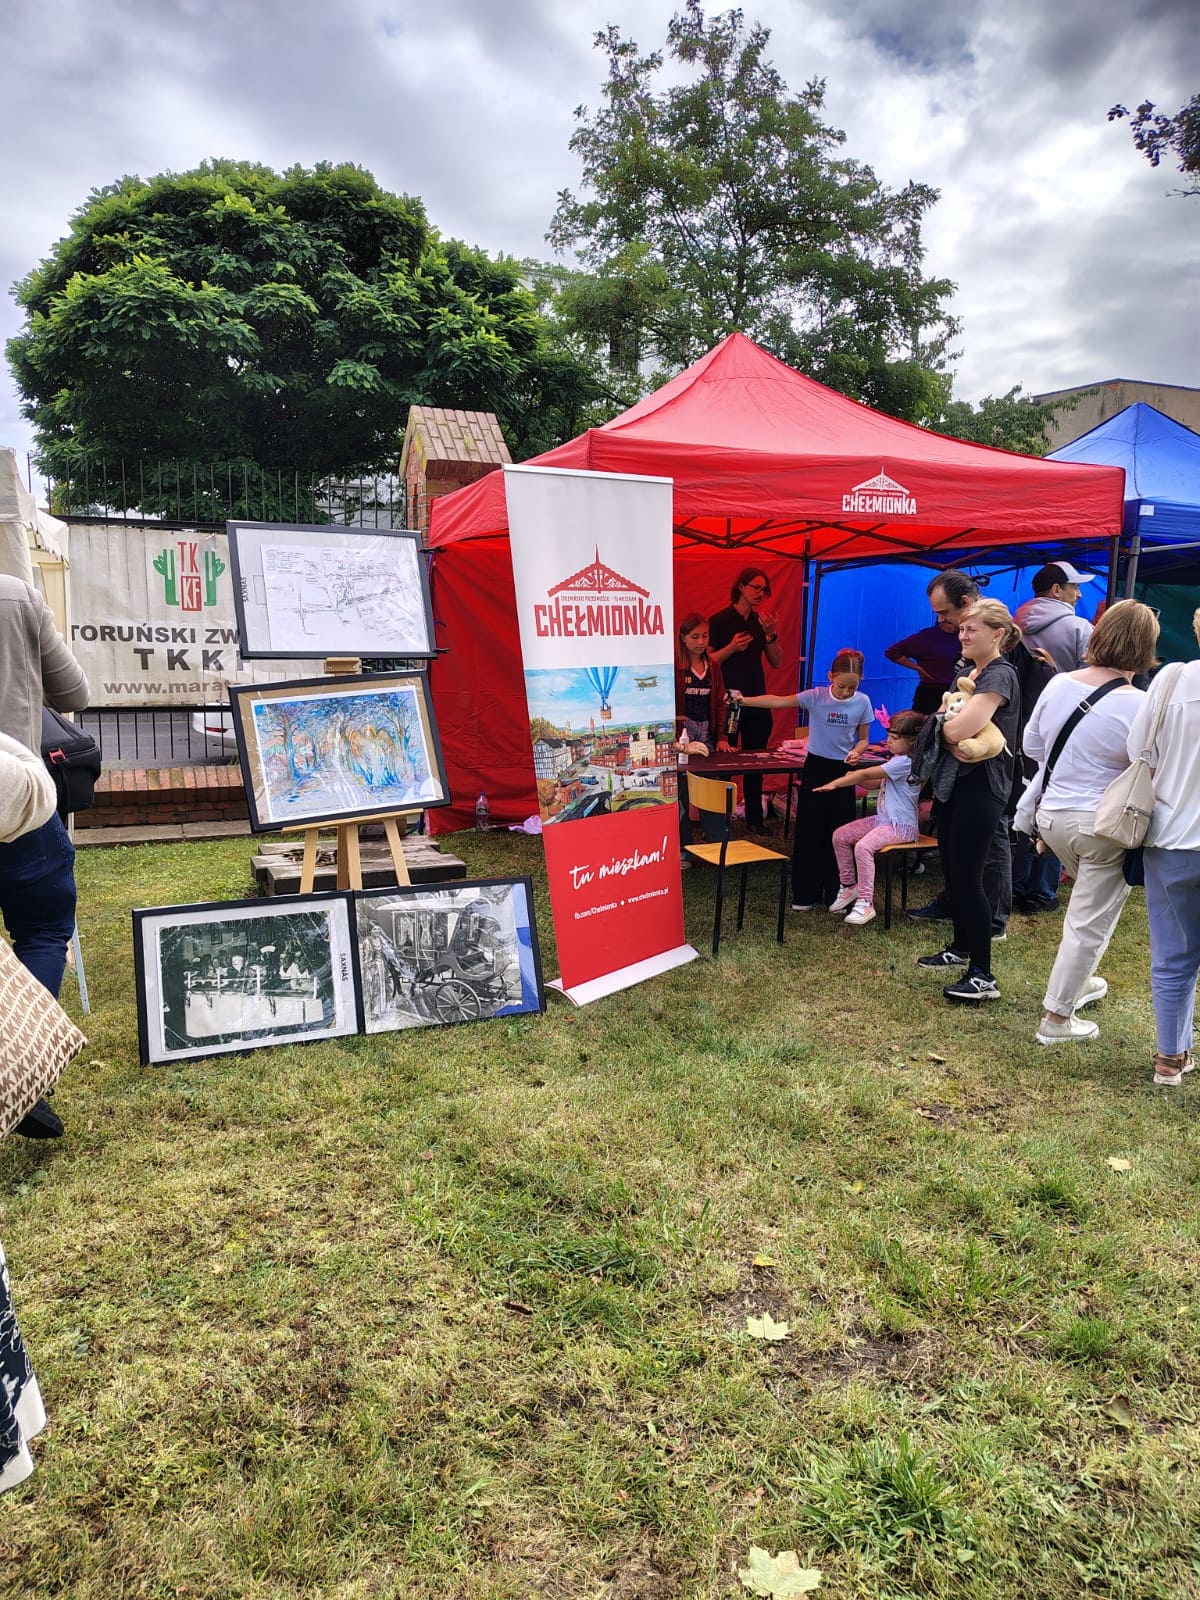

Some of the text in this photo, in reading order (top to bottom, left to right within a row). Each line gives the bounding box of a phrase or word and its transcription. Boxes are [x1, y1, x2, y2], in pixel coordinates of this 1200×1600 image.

[842, 491, 917, 515] CHEŁMIONKA
[177, 541, 199, 573] TK
[183, 577, 201, 610] KF
[534, 597, 665, 637] CHEŁMIONKA
[72, 623, 196, 644] TORUŃSKI
[103, 680, 243, 694] www.marat
[569, 835, 668, 890] tu mieszkam!
